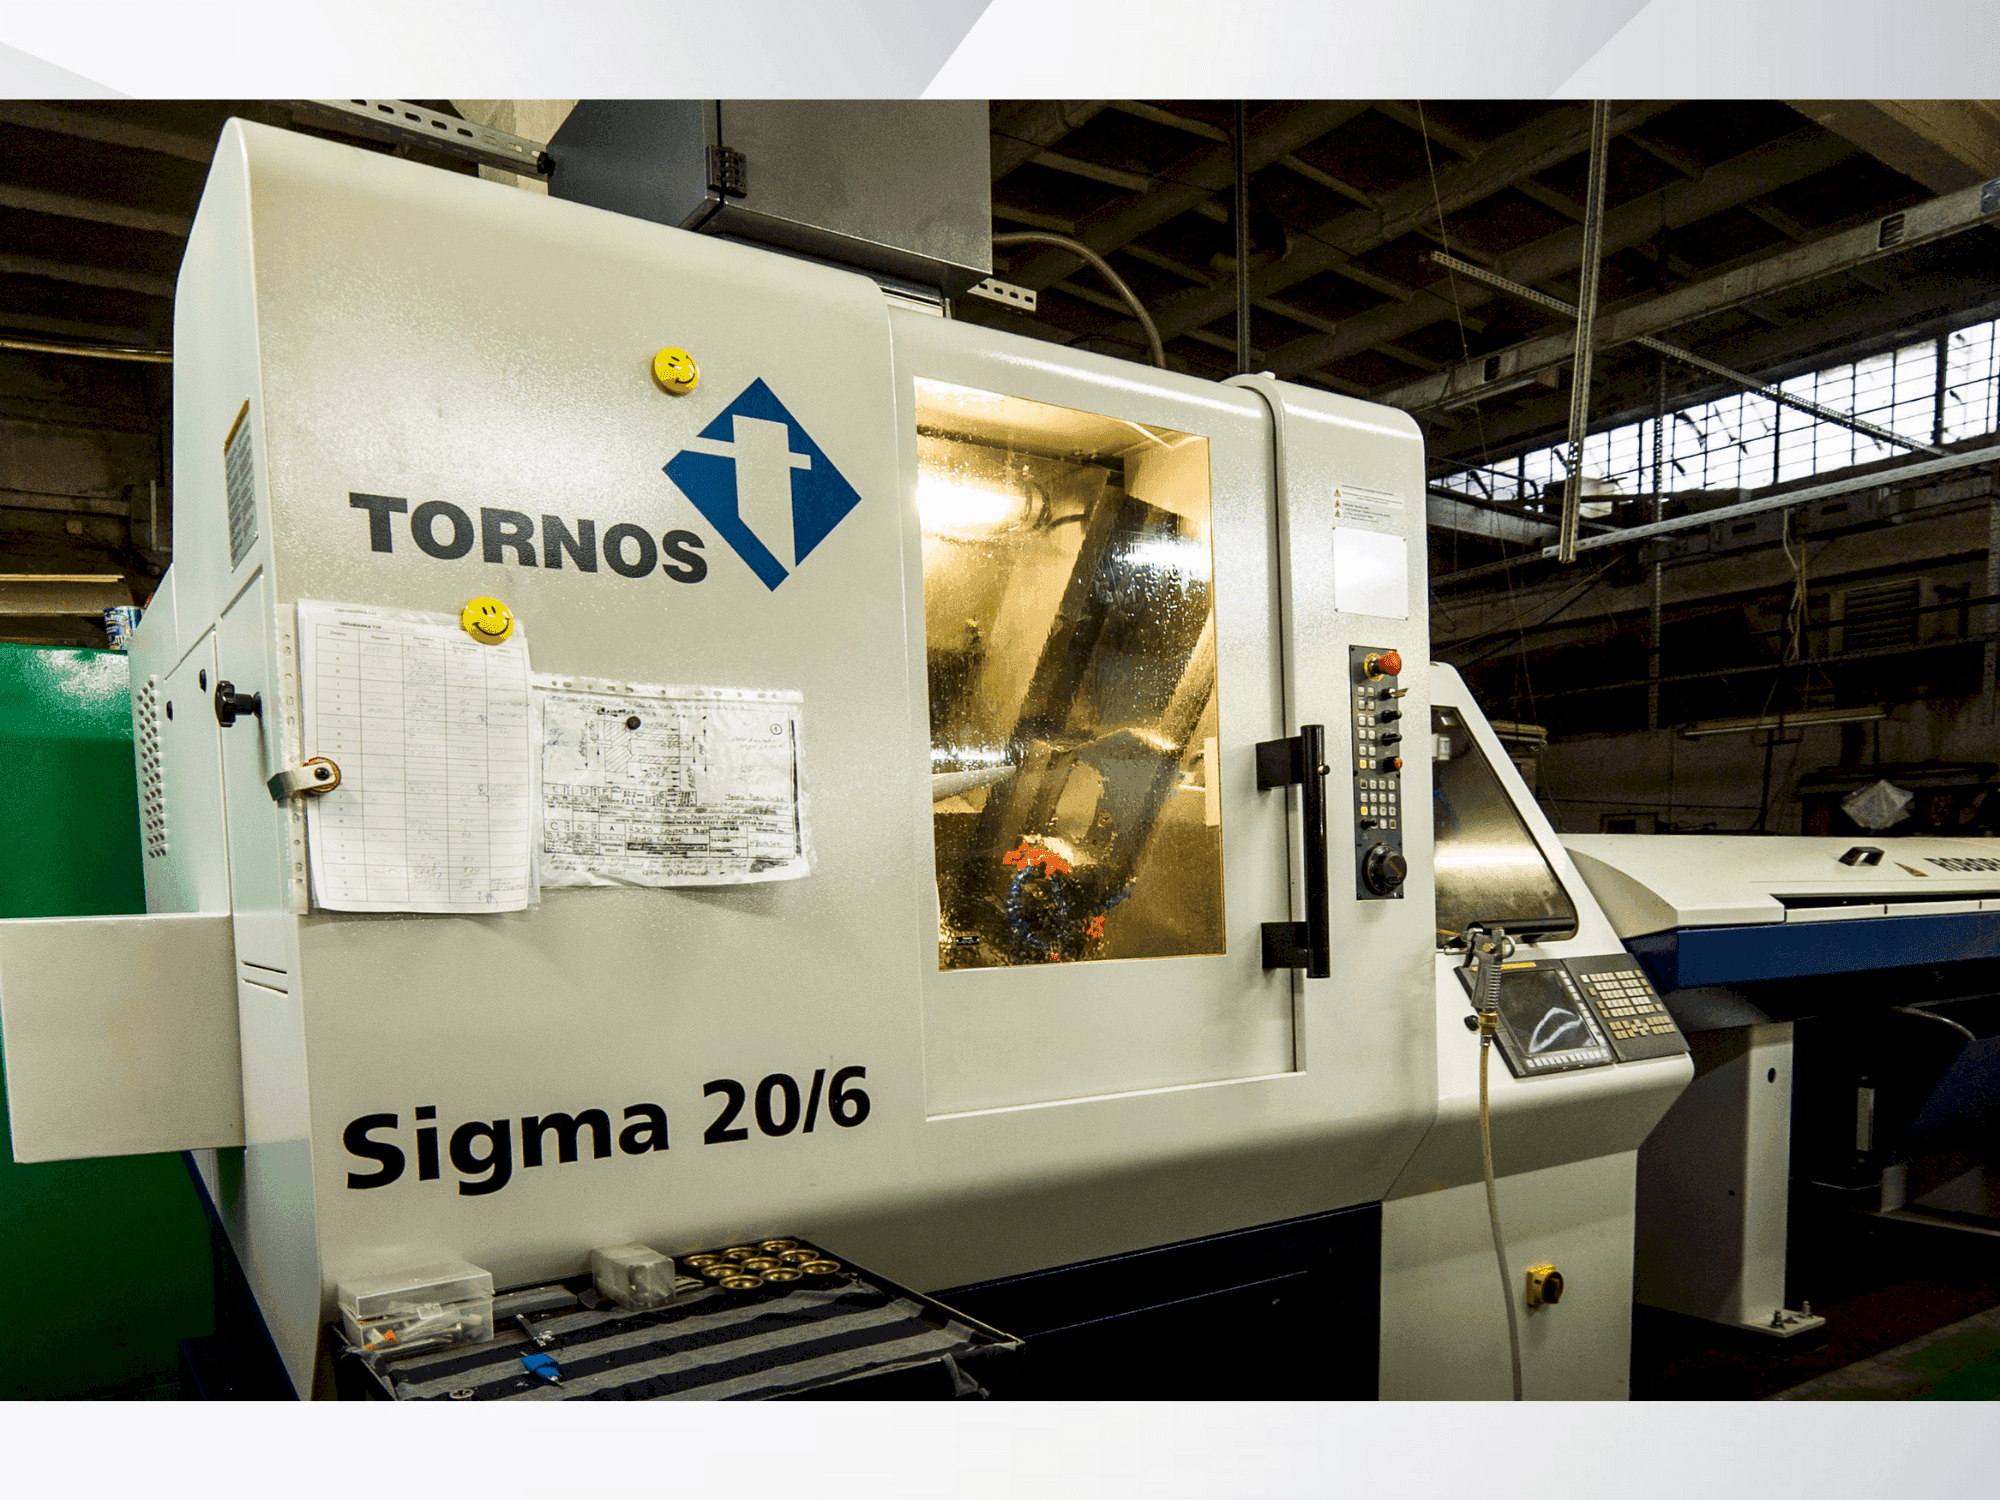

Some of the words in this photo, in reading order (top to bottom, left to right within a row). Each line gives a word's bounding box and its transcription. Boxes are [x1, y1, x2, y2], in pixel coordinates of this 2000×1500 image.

[349, 492, 708, 584] TORNOS
[1922, 857, 2000, 872] ROBOB
[342, 1103, 669, 1196] Sigma
[702, 1065, 871, 1145] 20/6
